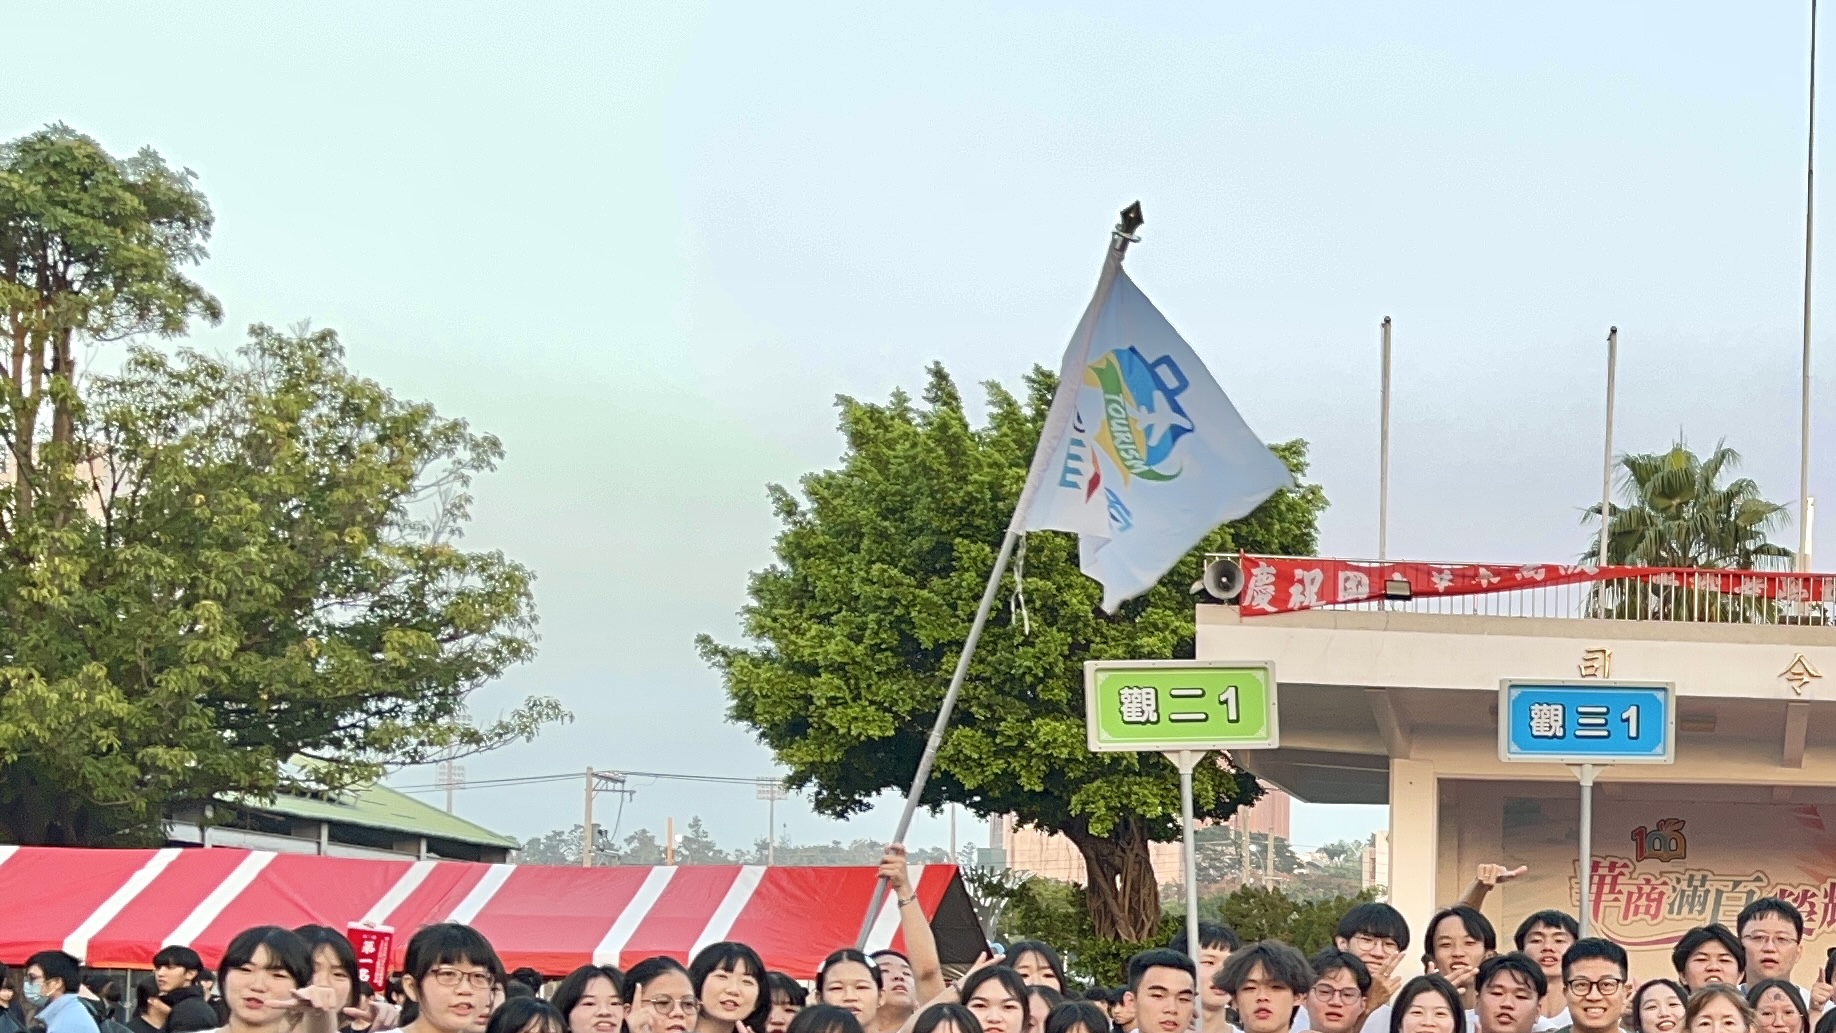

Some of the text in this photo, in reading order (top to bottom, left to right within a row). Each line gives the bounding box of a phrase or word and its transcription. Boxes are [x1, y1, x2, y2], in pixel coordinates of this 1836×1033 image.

[1104, 393, 1149, 474] TOURISM
[1117, 685, 1241, 724] 觀二1
[1528, 702, 1641, 739] 觀三1
